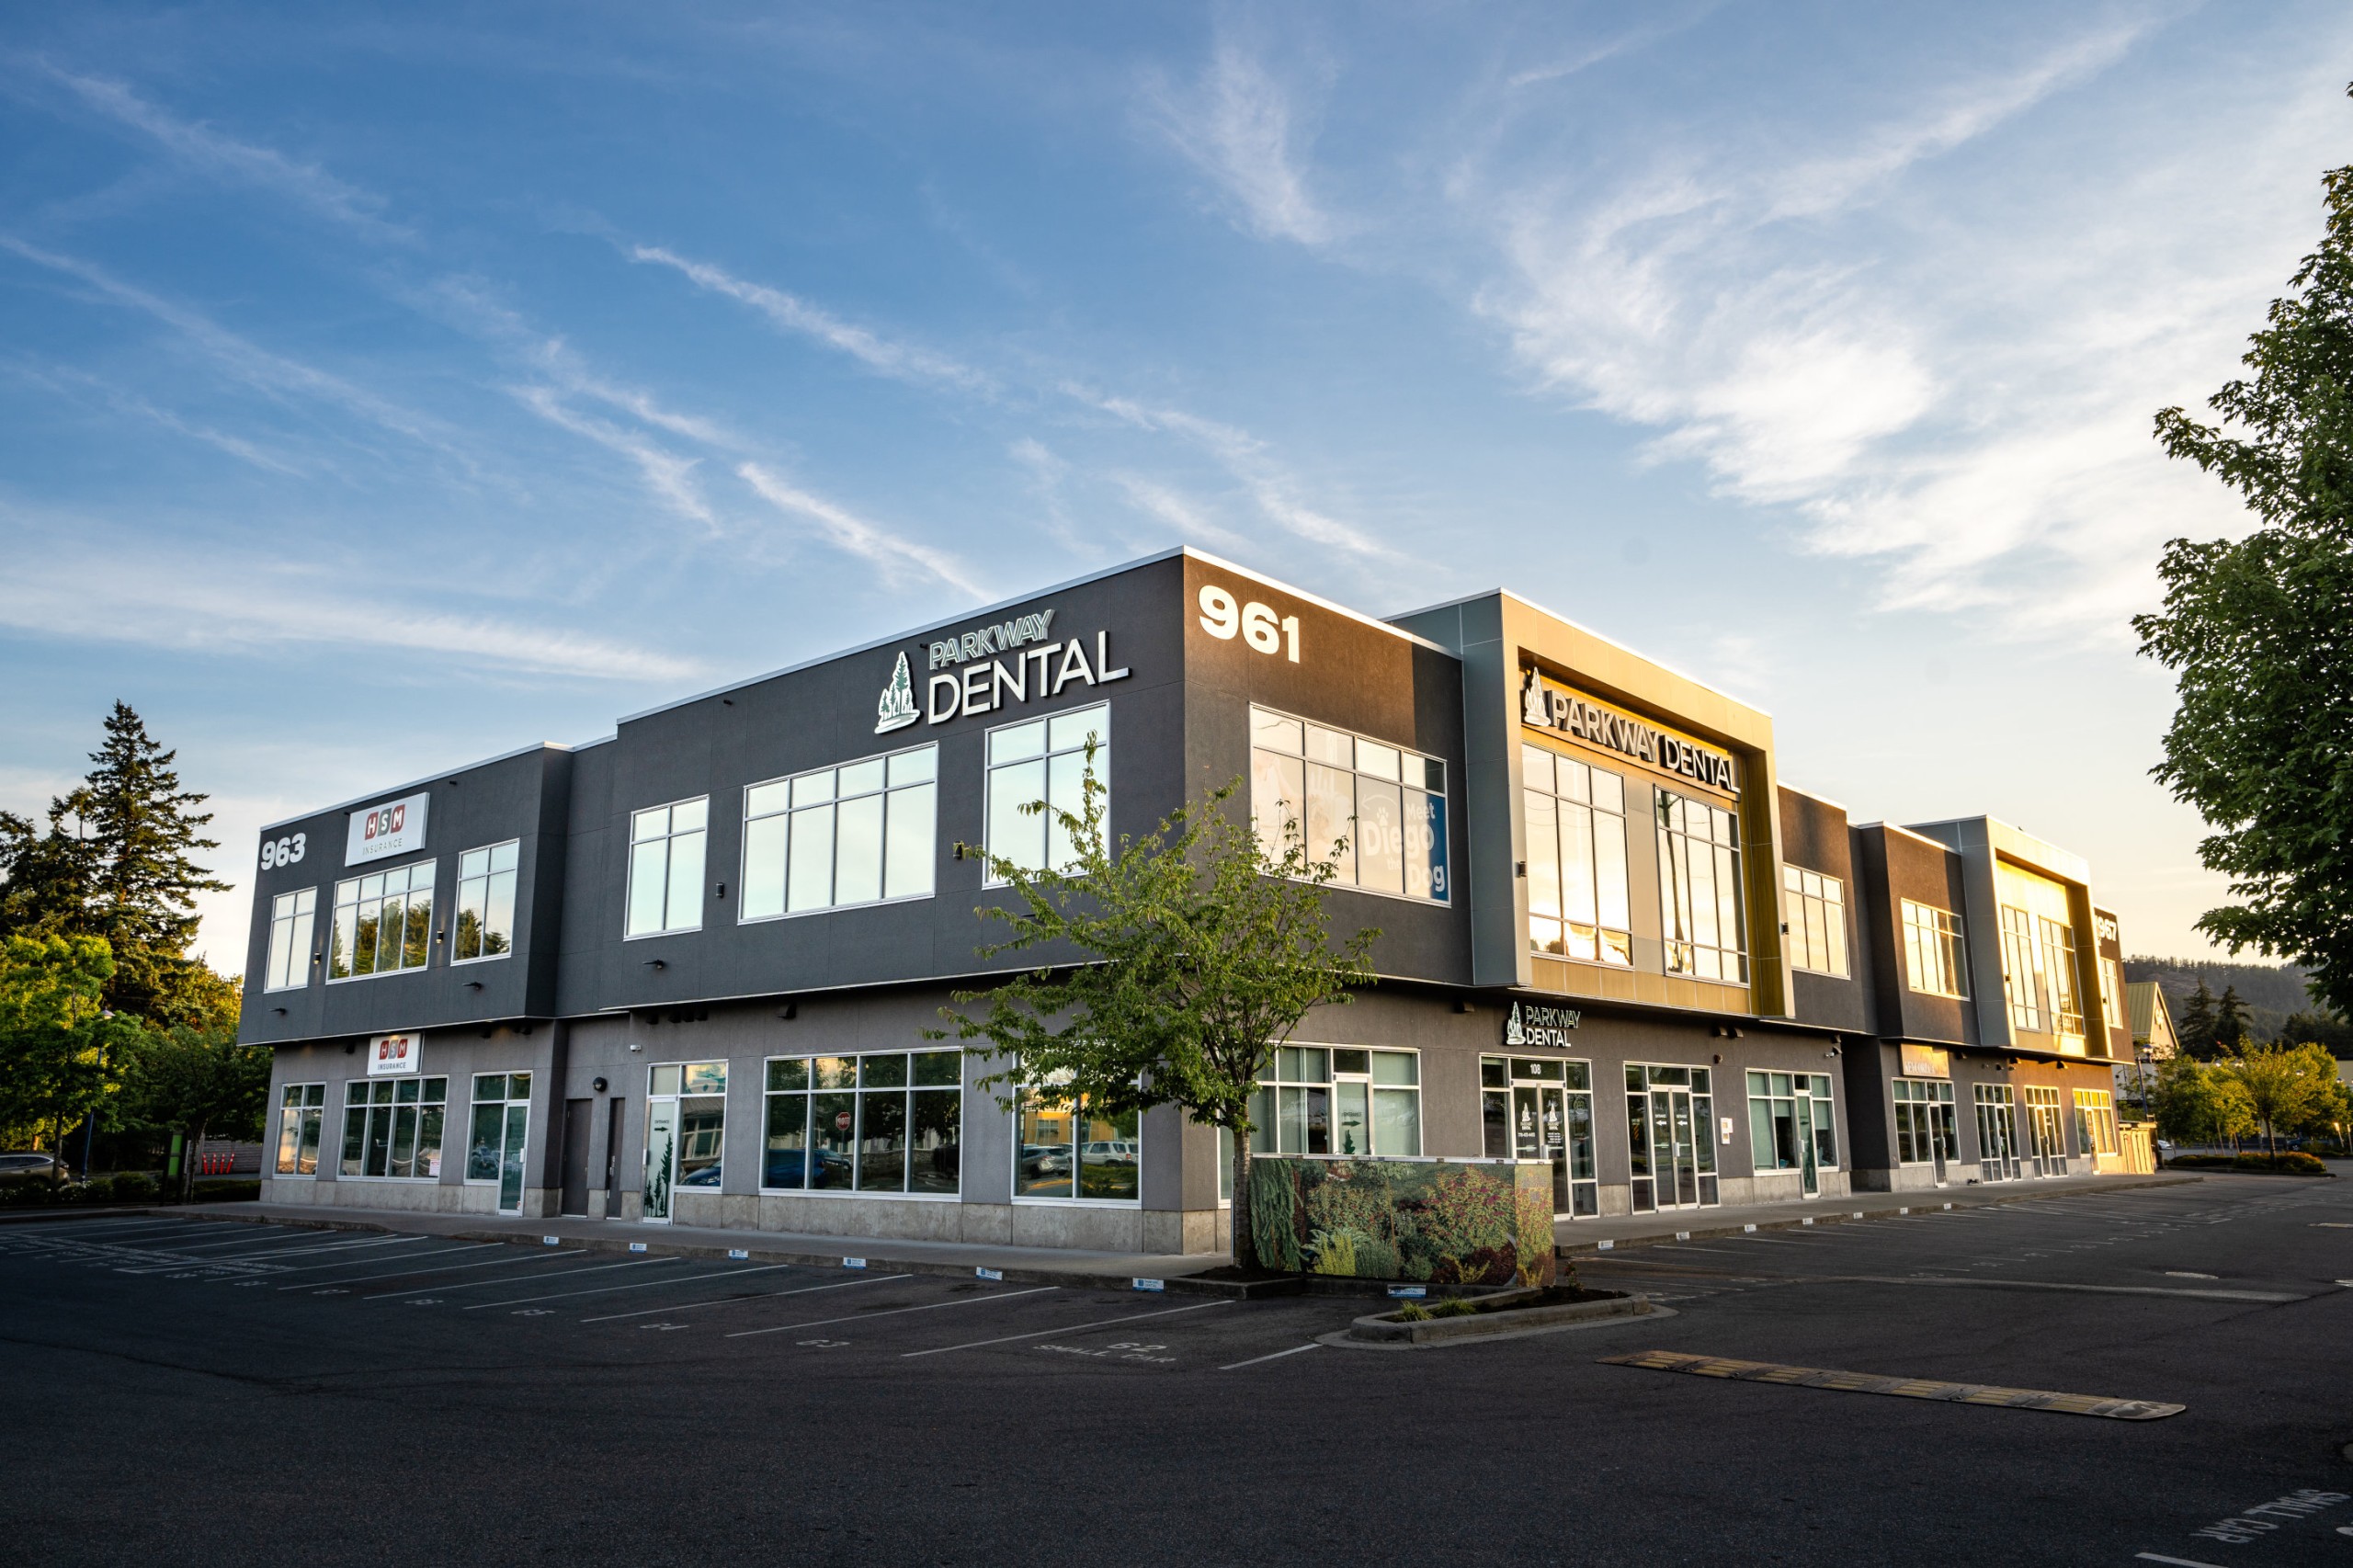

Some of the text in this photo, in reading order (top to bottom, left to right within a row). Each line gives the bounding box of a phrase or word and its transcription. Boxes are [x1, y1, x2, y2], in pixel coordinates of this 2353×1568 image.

[1199, 585, 1300, 664] 961
[929, 609, 1055, 670] PARKWAY
[928, 631, 1131, 725] DENTAL
[1548, 689, 1741, 794] PARKWAY DENTAL
[366, 808, 404, 837] HSM
[1405, 802, 1435, 821] Meet
[362, 837, 403, 856] INSURANCE
[1361, 819, 1434, 859] Diego
[261, 833, 306, 870] 963
[1406, 863, 1445, 892] Dog
[2097, 915, 2117, 941] 967
[1526, 1006, 1580, 1028] PARKWAY
[380, 1040, 407, 1058] HSM
[1527, 1028, 1572, 1047] DENTAL
[377, 1062, 406, 1071] INSURANCE
[1529, 1063, 1541, 1074] 108
[796, 1339, 850, 1347] 63
[1032, 1345, 1176, 1363] SMALL CAR
[1107, 1342, 1167, 1352] 62
[2188, 1489, 2351, 1543] SMALL CAR
